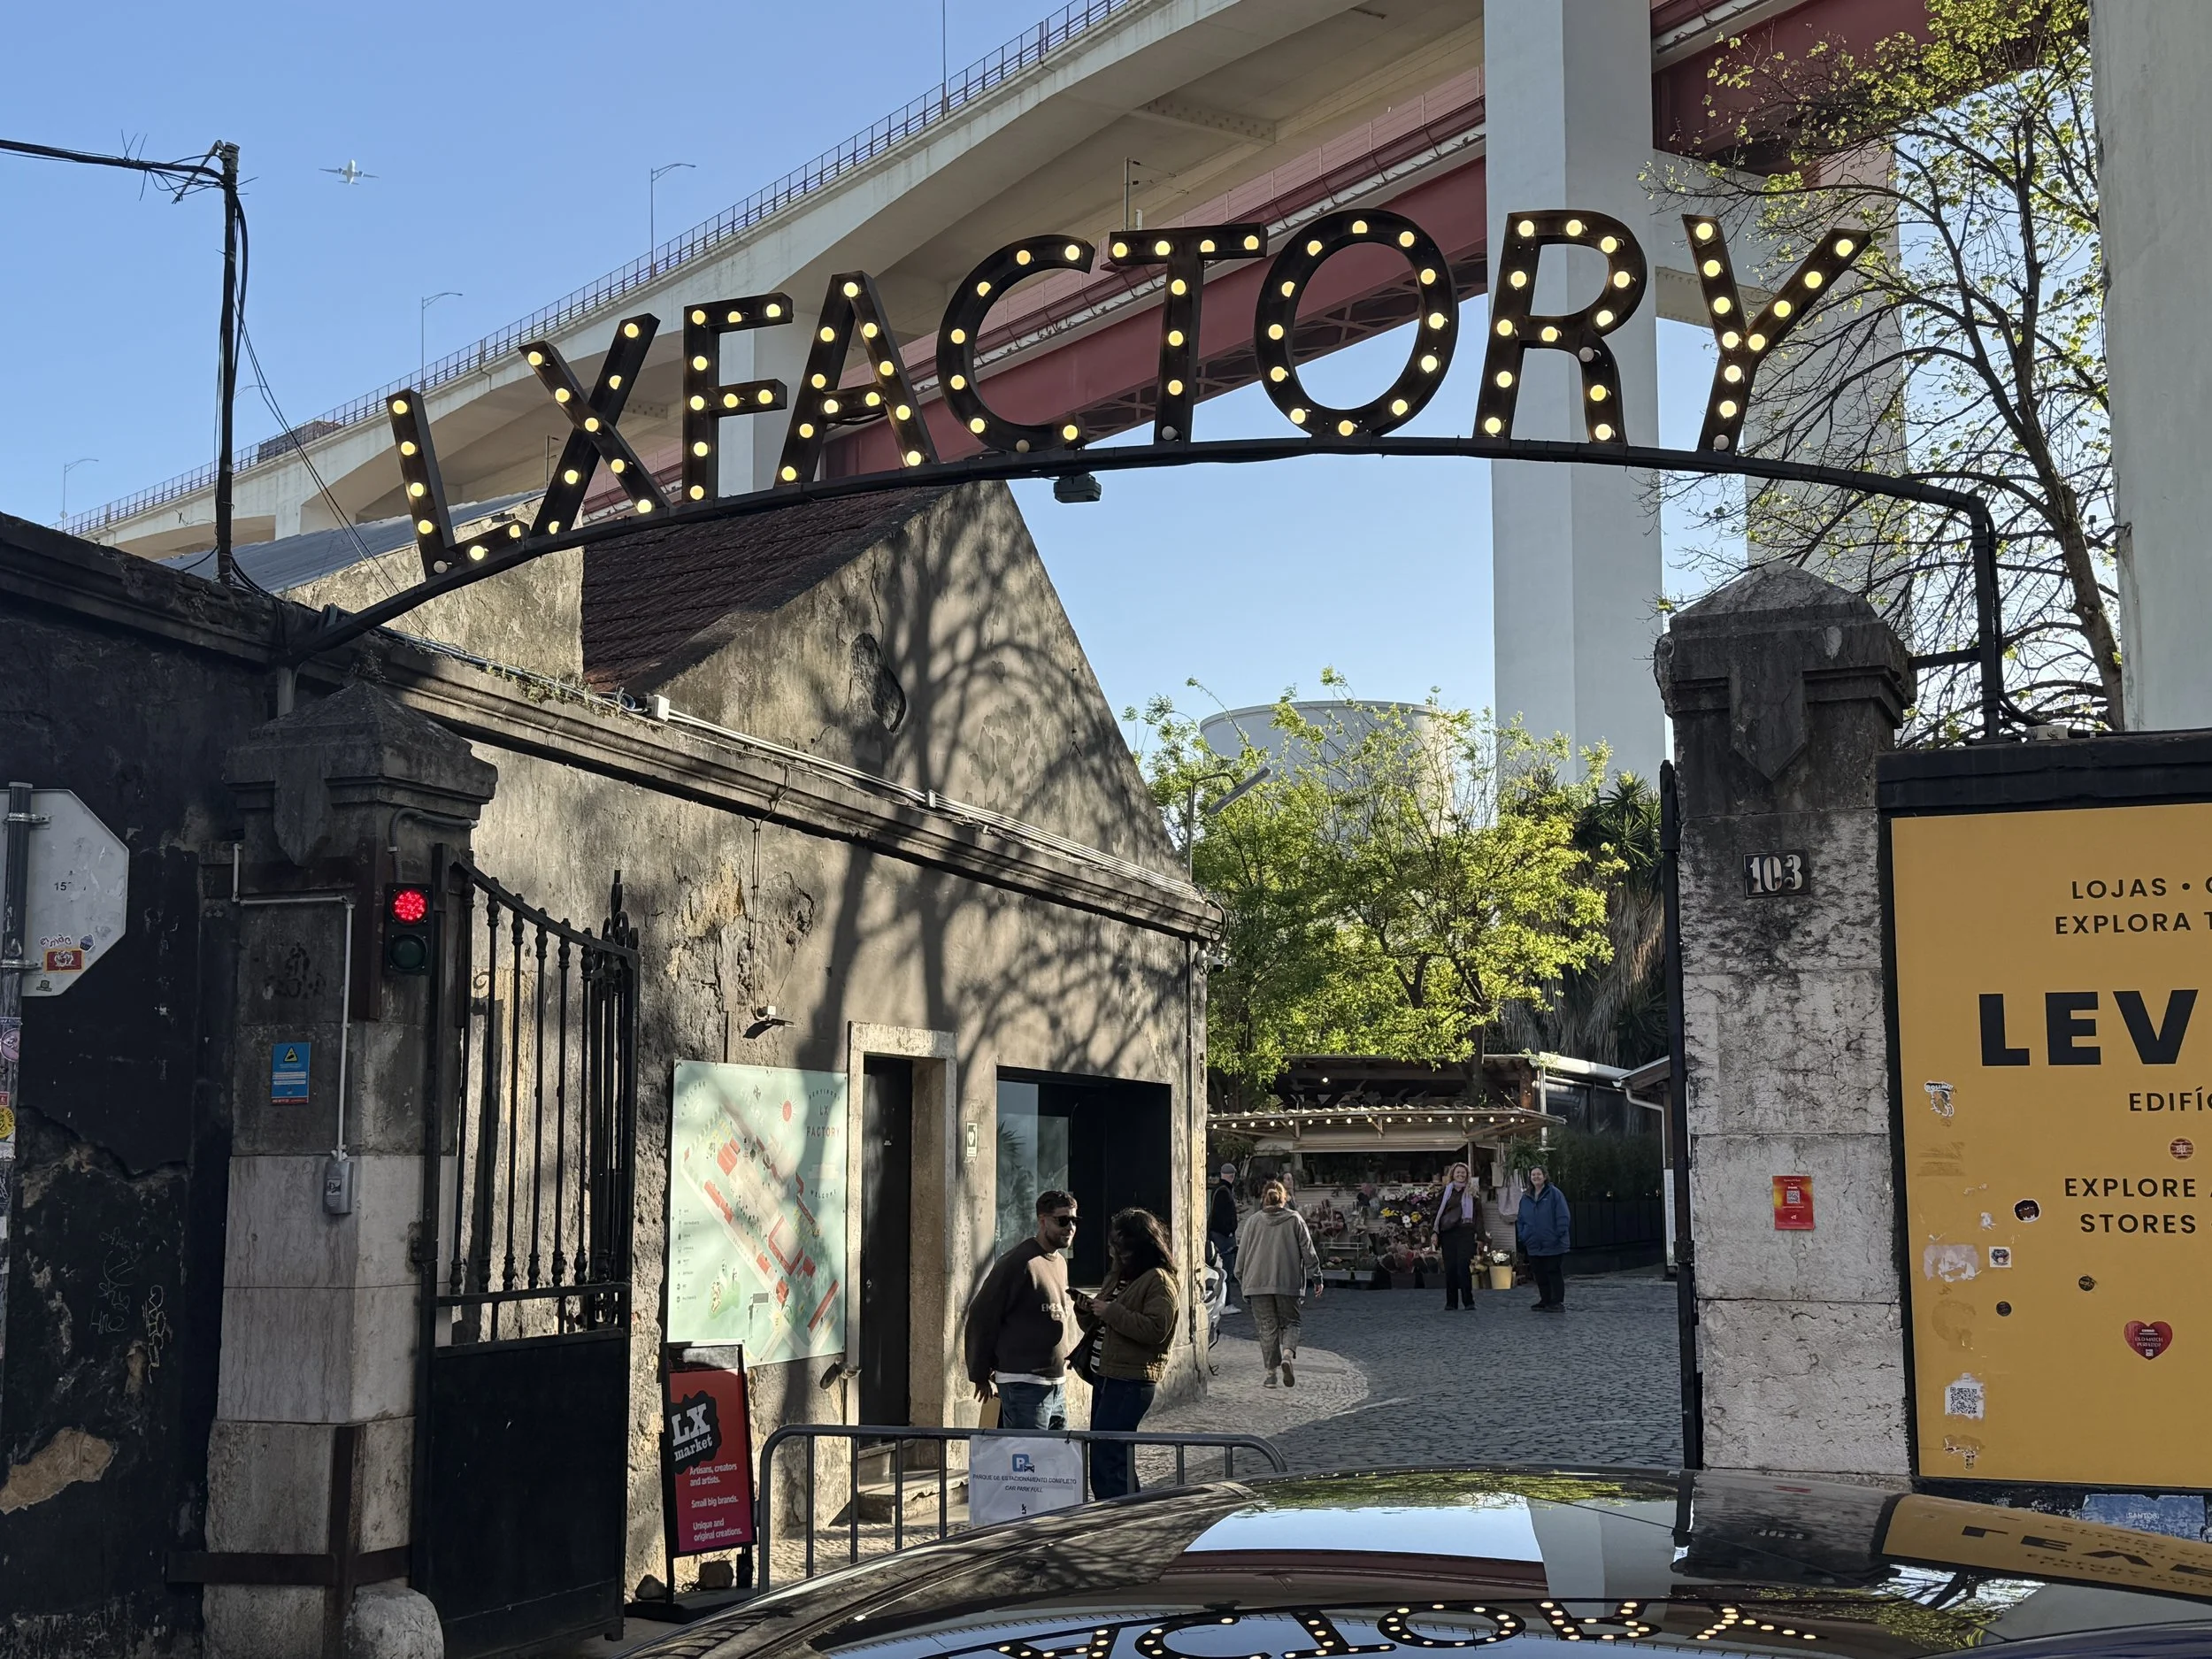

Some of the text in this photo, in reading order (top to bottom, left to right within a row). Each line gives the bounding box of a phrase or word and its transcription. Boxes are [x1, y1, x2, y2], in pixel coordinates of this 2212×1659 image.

[1750, 854, 1803, 893] 103
[2072, 878, 2167, 899] LOJAS
[2055, 912, 2191, 934] EXPLORA
[1978, 989, 2199, 1066] LEV
[819, 1105, 829, 1116] LX
[806, 1125, 841, 1137] FACTORY
[2064, 1178, 2196, 1197] EXPLORE
[2080, 1214, 2196, 1233] STORES
[672, 1402, 711, 1448] LX
[673, 1434, 713, 1462] market
[689, 1463, 737, 1476] Artisans, creators
[690, 1476, 720, 1486] and artists.
[691, 1494, 739, 1509] Small big brands.
[693, 1517, 724, 1531] Unique and
[694, 1527, 742, 1542] original creations.
